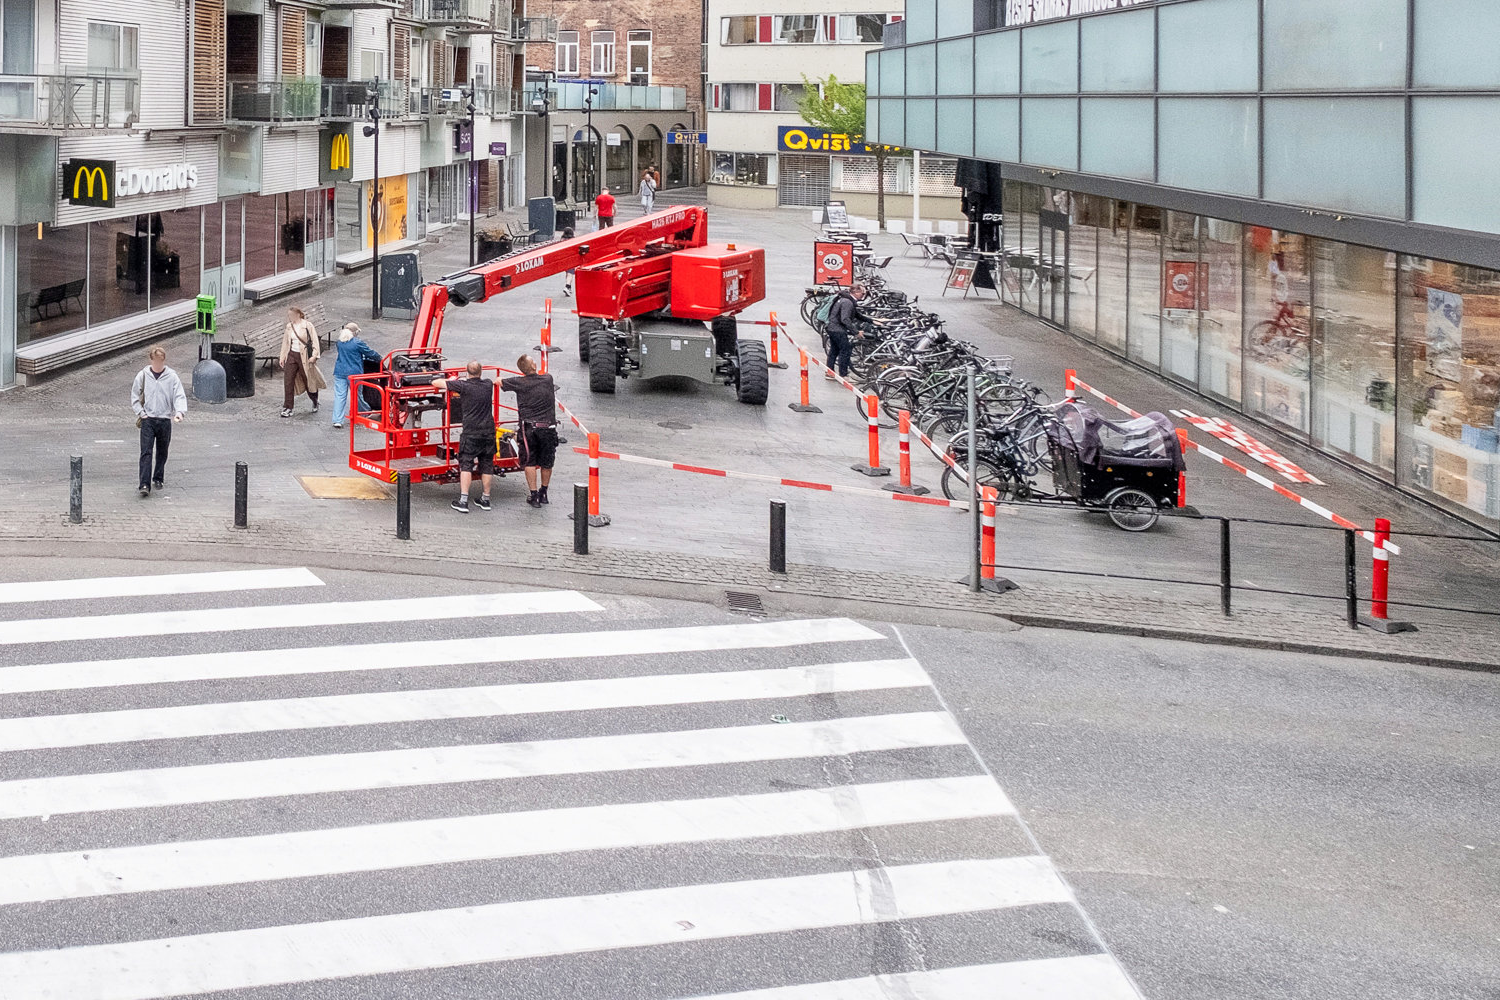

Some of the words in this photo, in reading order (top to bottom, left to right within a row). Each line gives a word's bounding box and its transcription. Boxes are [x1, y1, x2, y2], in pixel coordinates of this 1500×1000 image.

[784, 129, 850, 151] Qvist
[115, 163, 198, 197] cDonald's
[520, 256, 544, 272] LOXAM
[824, 258, 843, 267] 40,-
[360, 461, 382, 475] LOXAM
